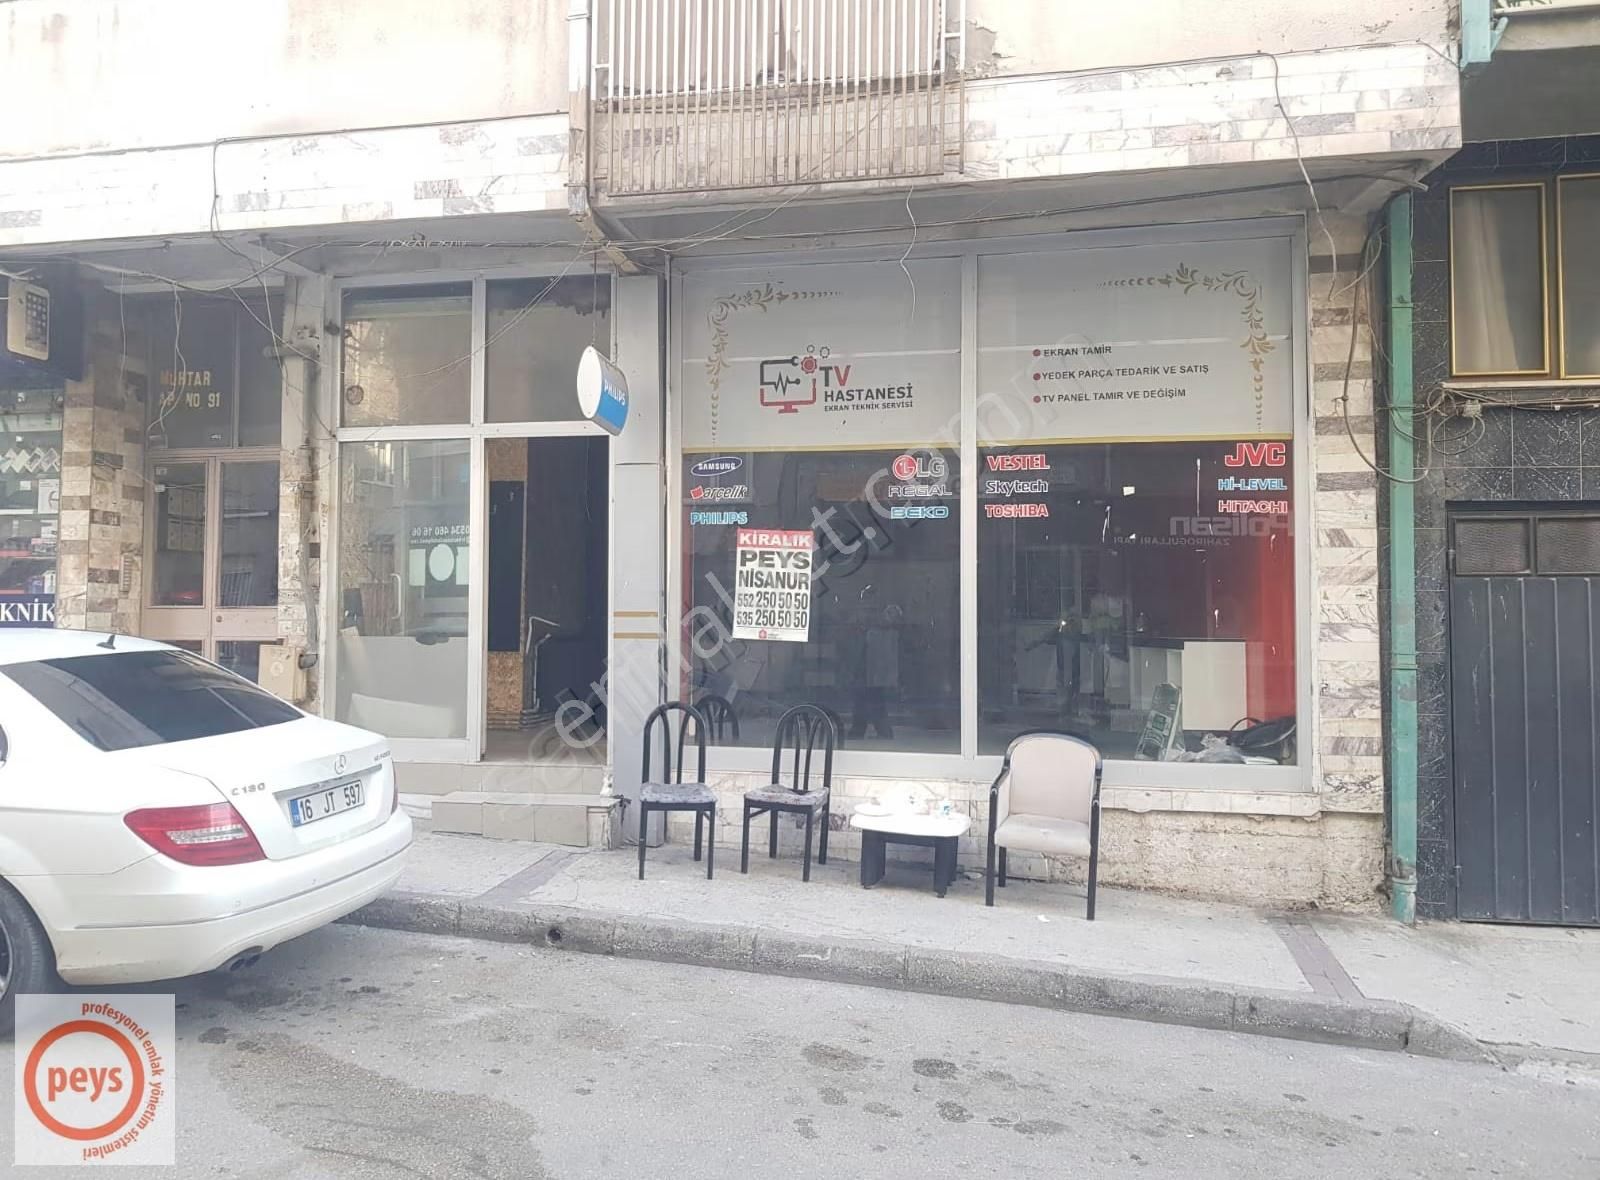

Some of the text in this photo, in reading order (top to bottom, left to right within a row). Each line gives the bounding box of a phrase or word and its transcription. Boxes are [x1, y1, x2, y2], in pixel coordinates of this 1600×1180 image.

[1043, 344, 1112, 357] EKRAN TAMİR
[819, 365, 851, 387] TV
[1042, 364, 1209, 380] YEDEK PARÇA TEDARİK VE SATIŞ
[207, 393, 220, 408] 91
[604, 379, 626, 406] PHILIPS
[824, 382, 913, 403] HASTANESİ
[1042, 395, 1055, 403] TV
[1058, 393, 1090, 402] PANEL
[1126, 390, 1140, 399] VE
[1143, 387, 1186, 399] DEĞİŞİM
[824, 404, 849, 412] EKRAN
[851, 402, 880, 411] TEKNİK
[986, 454, 1050, 471] VESTEL
[1225, 443, 1286, 467] JVC
[698, 462, 736, 470] SAMSUNG
[917, 457, 945, 478] LG
[703, 485, 748, 502] arçelik
[888, 484, 953, 497] REGAL
[985, 479, 1049, 497] Skytech
[890, 506, 949, 519] BEKO
[985, 504, 1049, 518] TOSHIBA
[1218, 500, 1288, 513] HITACHI
[690, 511, 748, 525] PHILIPS
[739, 530, 812, 547] KİRALIK
[740, 550, 810, 569] PEYS
[738, 568, 809, 590] NİSANUR
[737, 591, 808, 610] 552 250 50 50
[736, 609, 807, 628] 535 250 50 50
[300, 783, 361, 821] 16 JT 597
